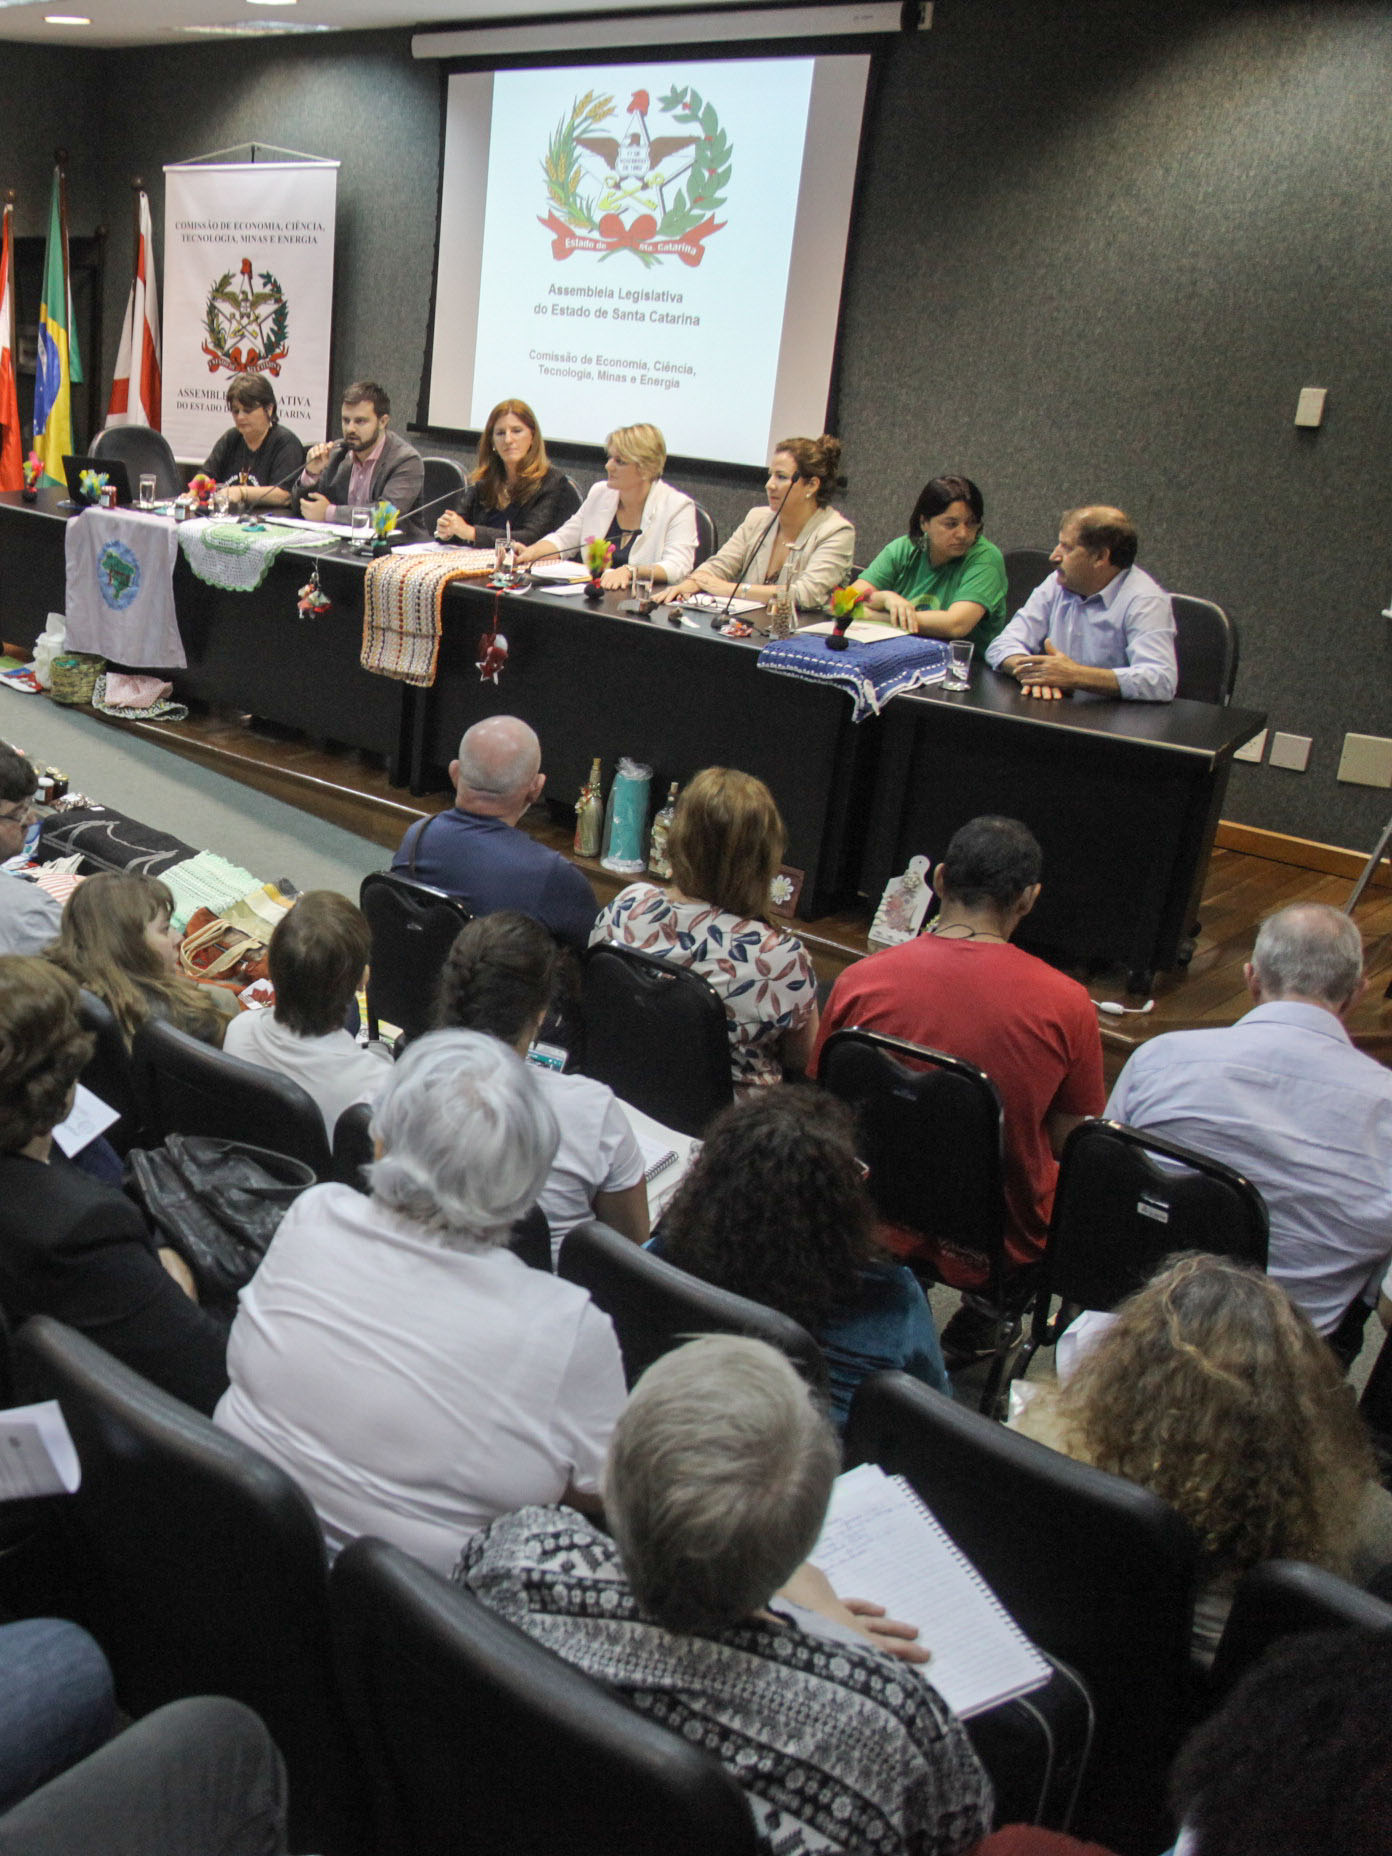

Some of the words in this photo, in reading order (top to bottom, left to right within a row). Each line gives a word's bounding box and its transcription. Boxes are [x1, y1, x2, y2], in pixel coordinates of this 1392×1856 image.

[175, 220, 219, 230] COMISSÃO
[220, 222, 230, 230] DE
[233, 222, 283, 231] ECONOMIA,
[285, 220, 326, 232] CIÊNCIA,
[181, 234, 239, 244] TECNOLOGIA,
[241, 235, 268, 244] MINAS
[277, 235, 318, 245] ENERGIA
[657, 242, 697, 256] Catarina
[548, 283, 615, 299] Assembleia
[618, 287, 684, 304] Legislativa
[533, 303, 548, 315] do
[551, 303, 591, 318] Estado
[594, 306, 609, 319] de
[612, 307, 646, 323] Santa
[649, 310, 701, 327] Catarina
[528, 350, 578, 364] Comissão
[580, 353, 593, 365] de
[596, 355, 650, 372] Economia,
[653, 360, 697, 377] Ciência,
[538, 364, 594, 382] Tecnologia,
[597, 370, 627, 384] Minas
[630, 374, 637, 385] e
[640, 374, 681, 390] Energia
[177, 388, 228, 401] ASSEMBLE
[176, 402, 188, 410] DO
[190, 403, 222, 413] ESTADO
[279, 409, 311, 420] TARINA
